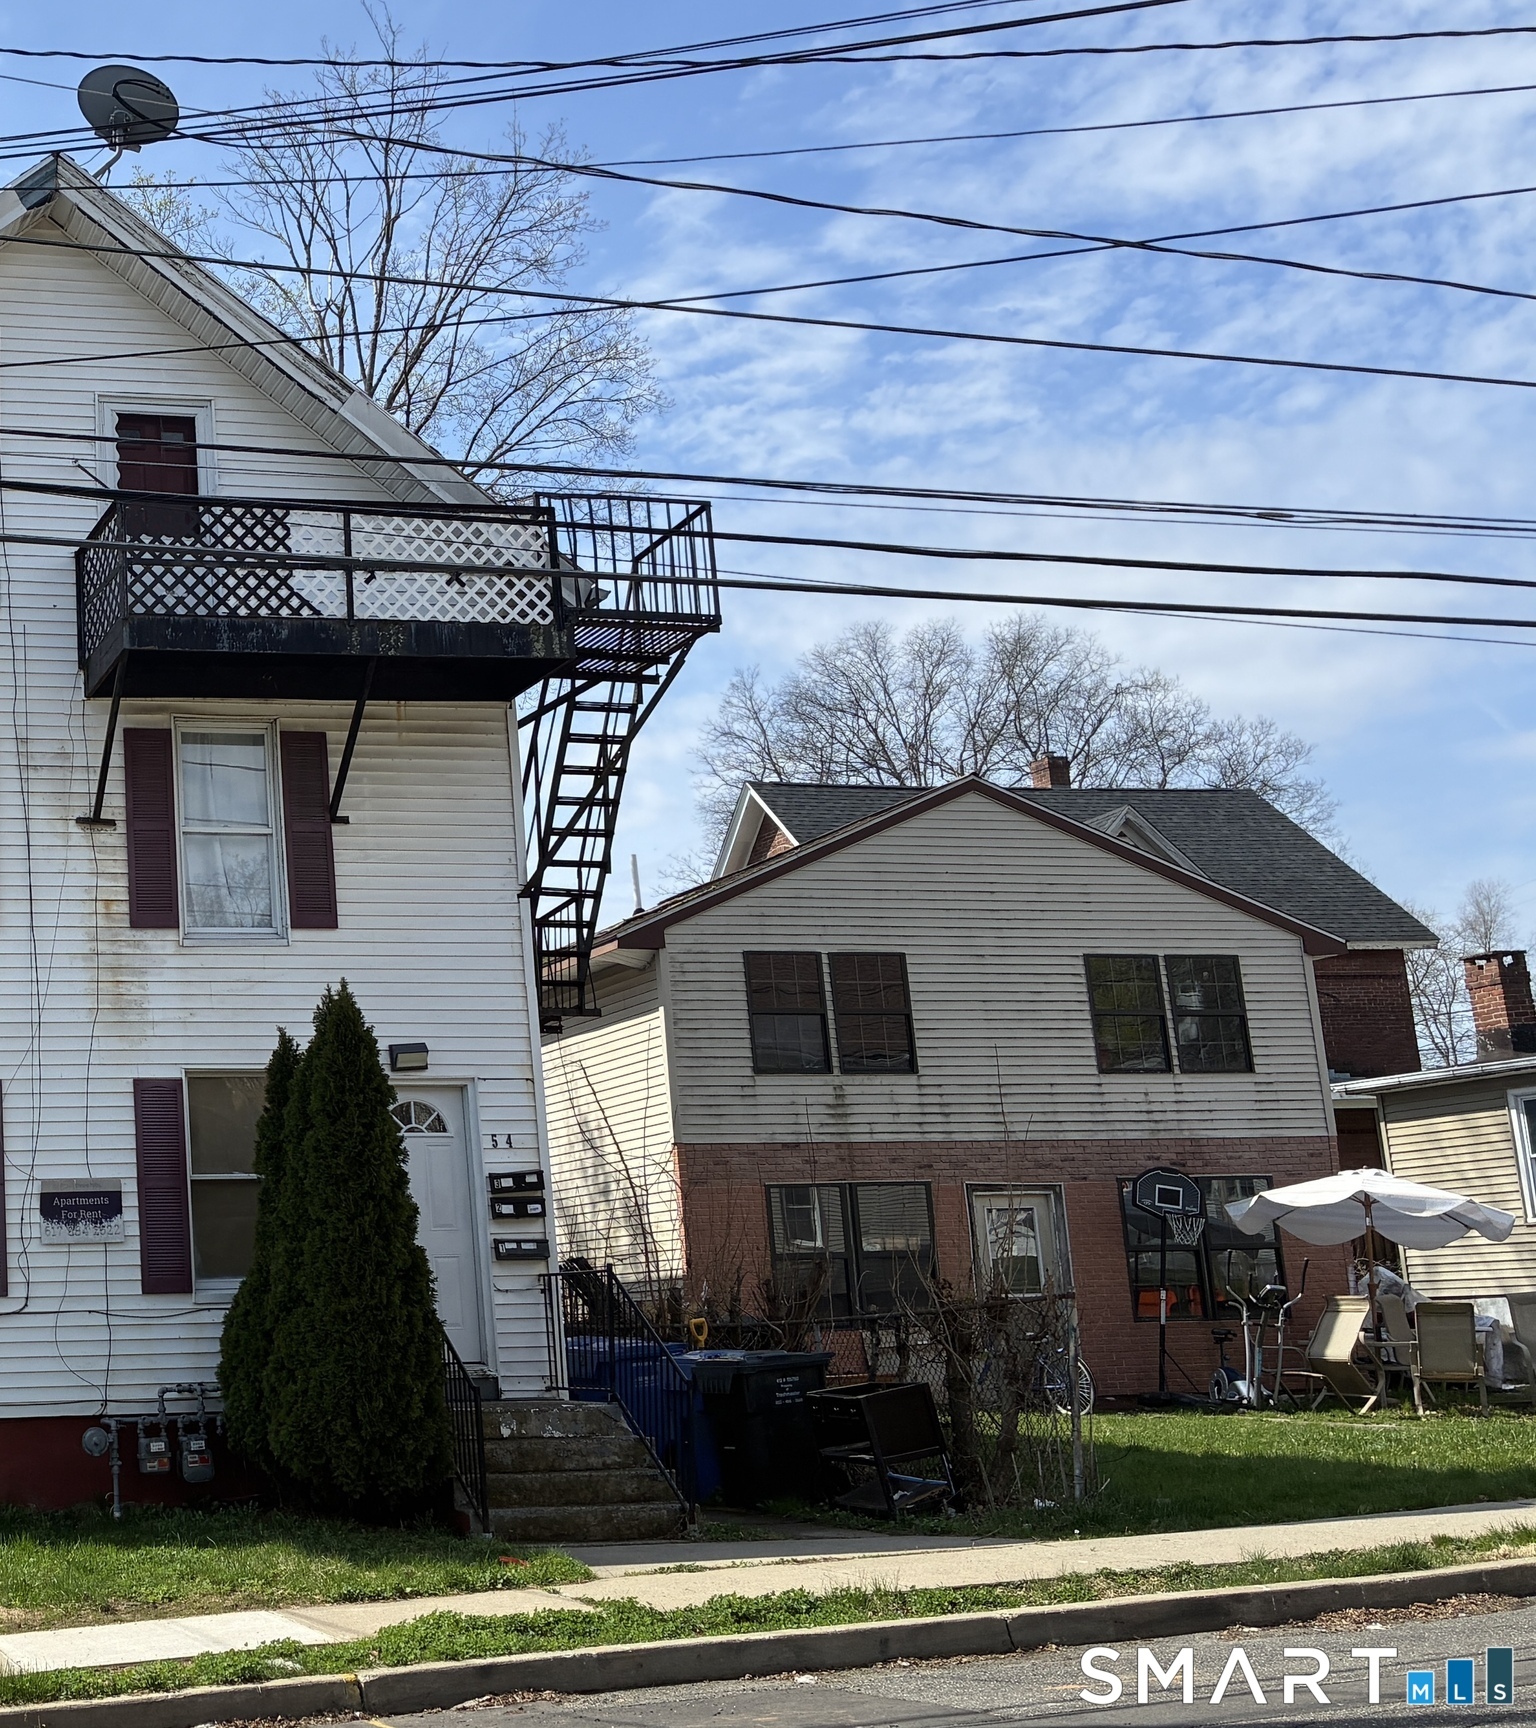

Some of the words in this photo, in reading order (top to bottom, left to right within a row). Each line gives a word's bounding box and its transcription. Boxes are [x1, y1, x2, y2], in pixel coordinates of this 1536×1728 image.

[53, 1197, 109, 1207] Apartments
[61, 1210, 77, 1219] For
[79, 1210, 102, 1219] Rent
[44, 1225, 63, 1237] 617
